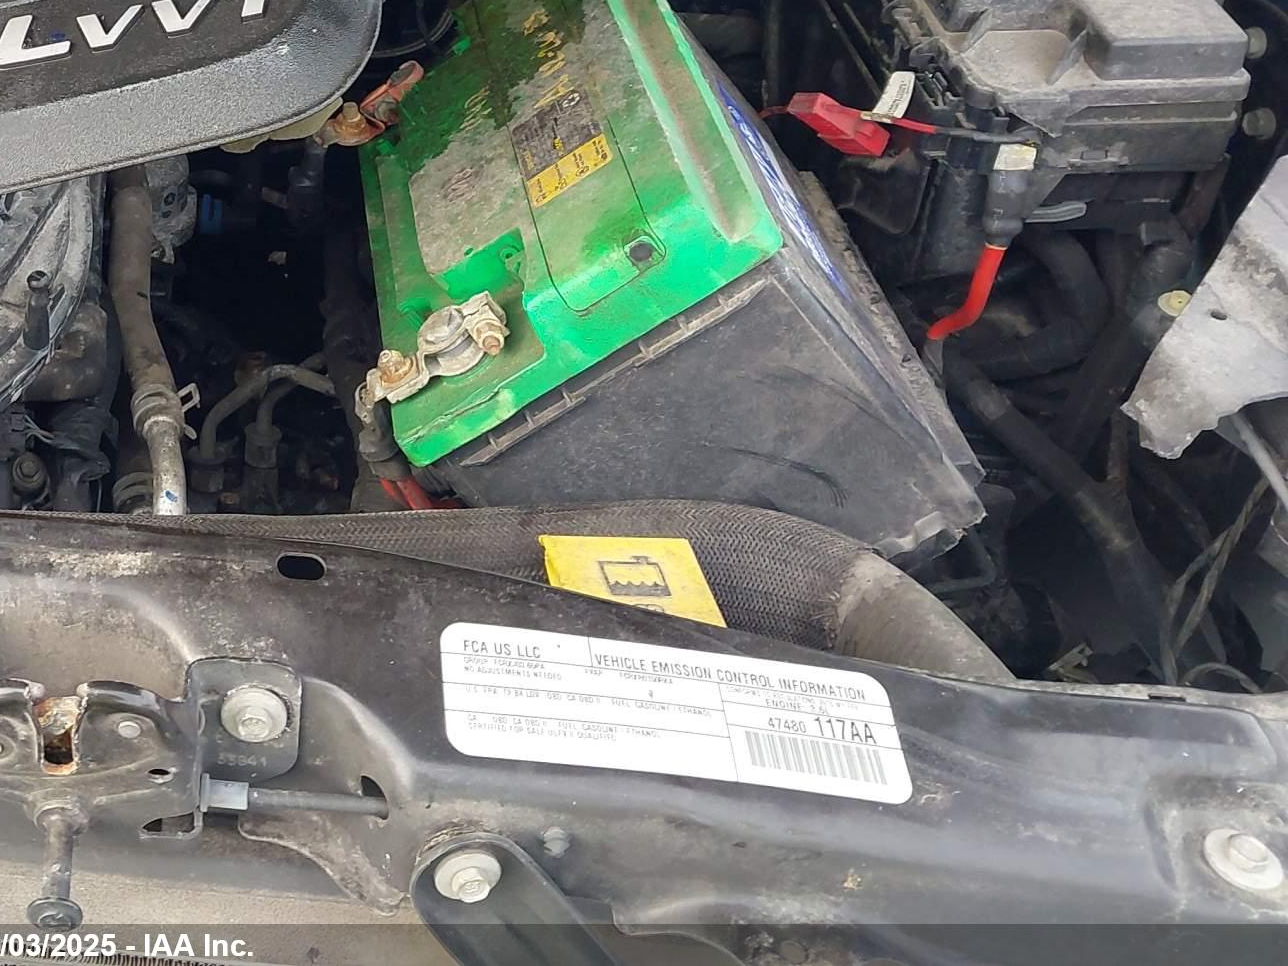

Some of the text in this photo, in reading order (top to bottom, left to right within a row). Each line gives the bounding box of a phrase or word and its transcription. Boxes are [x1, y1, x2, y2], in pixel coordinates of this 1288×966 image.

[463, 639, 541, 659] FCA US LLC
[594, 654, 647, 671] VEHICLE
[651, 661, 712, 680] EMISSION
[716, 669, 775, 689] CONTROL
[778, 678, 866, 701] INFORMATION
[813, 716, 878, 745] 117AA
